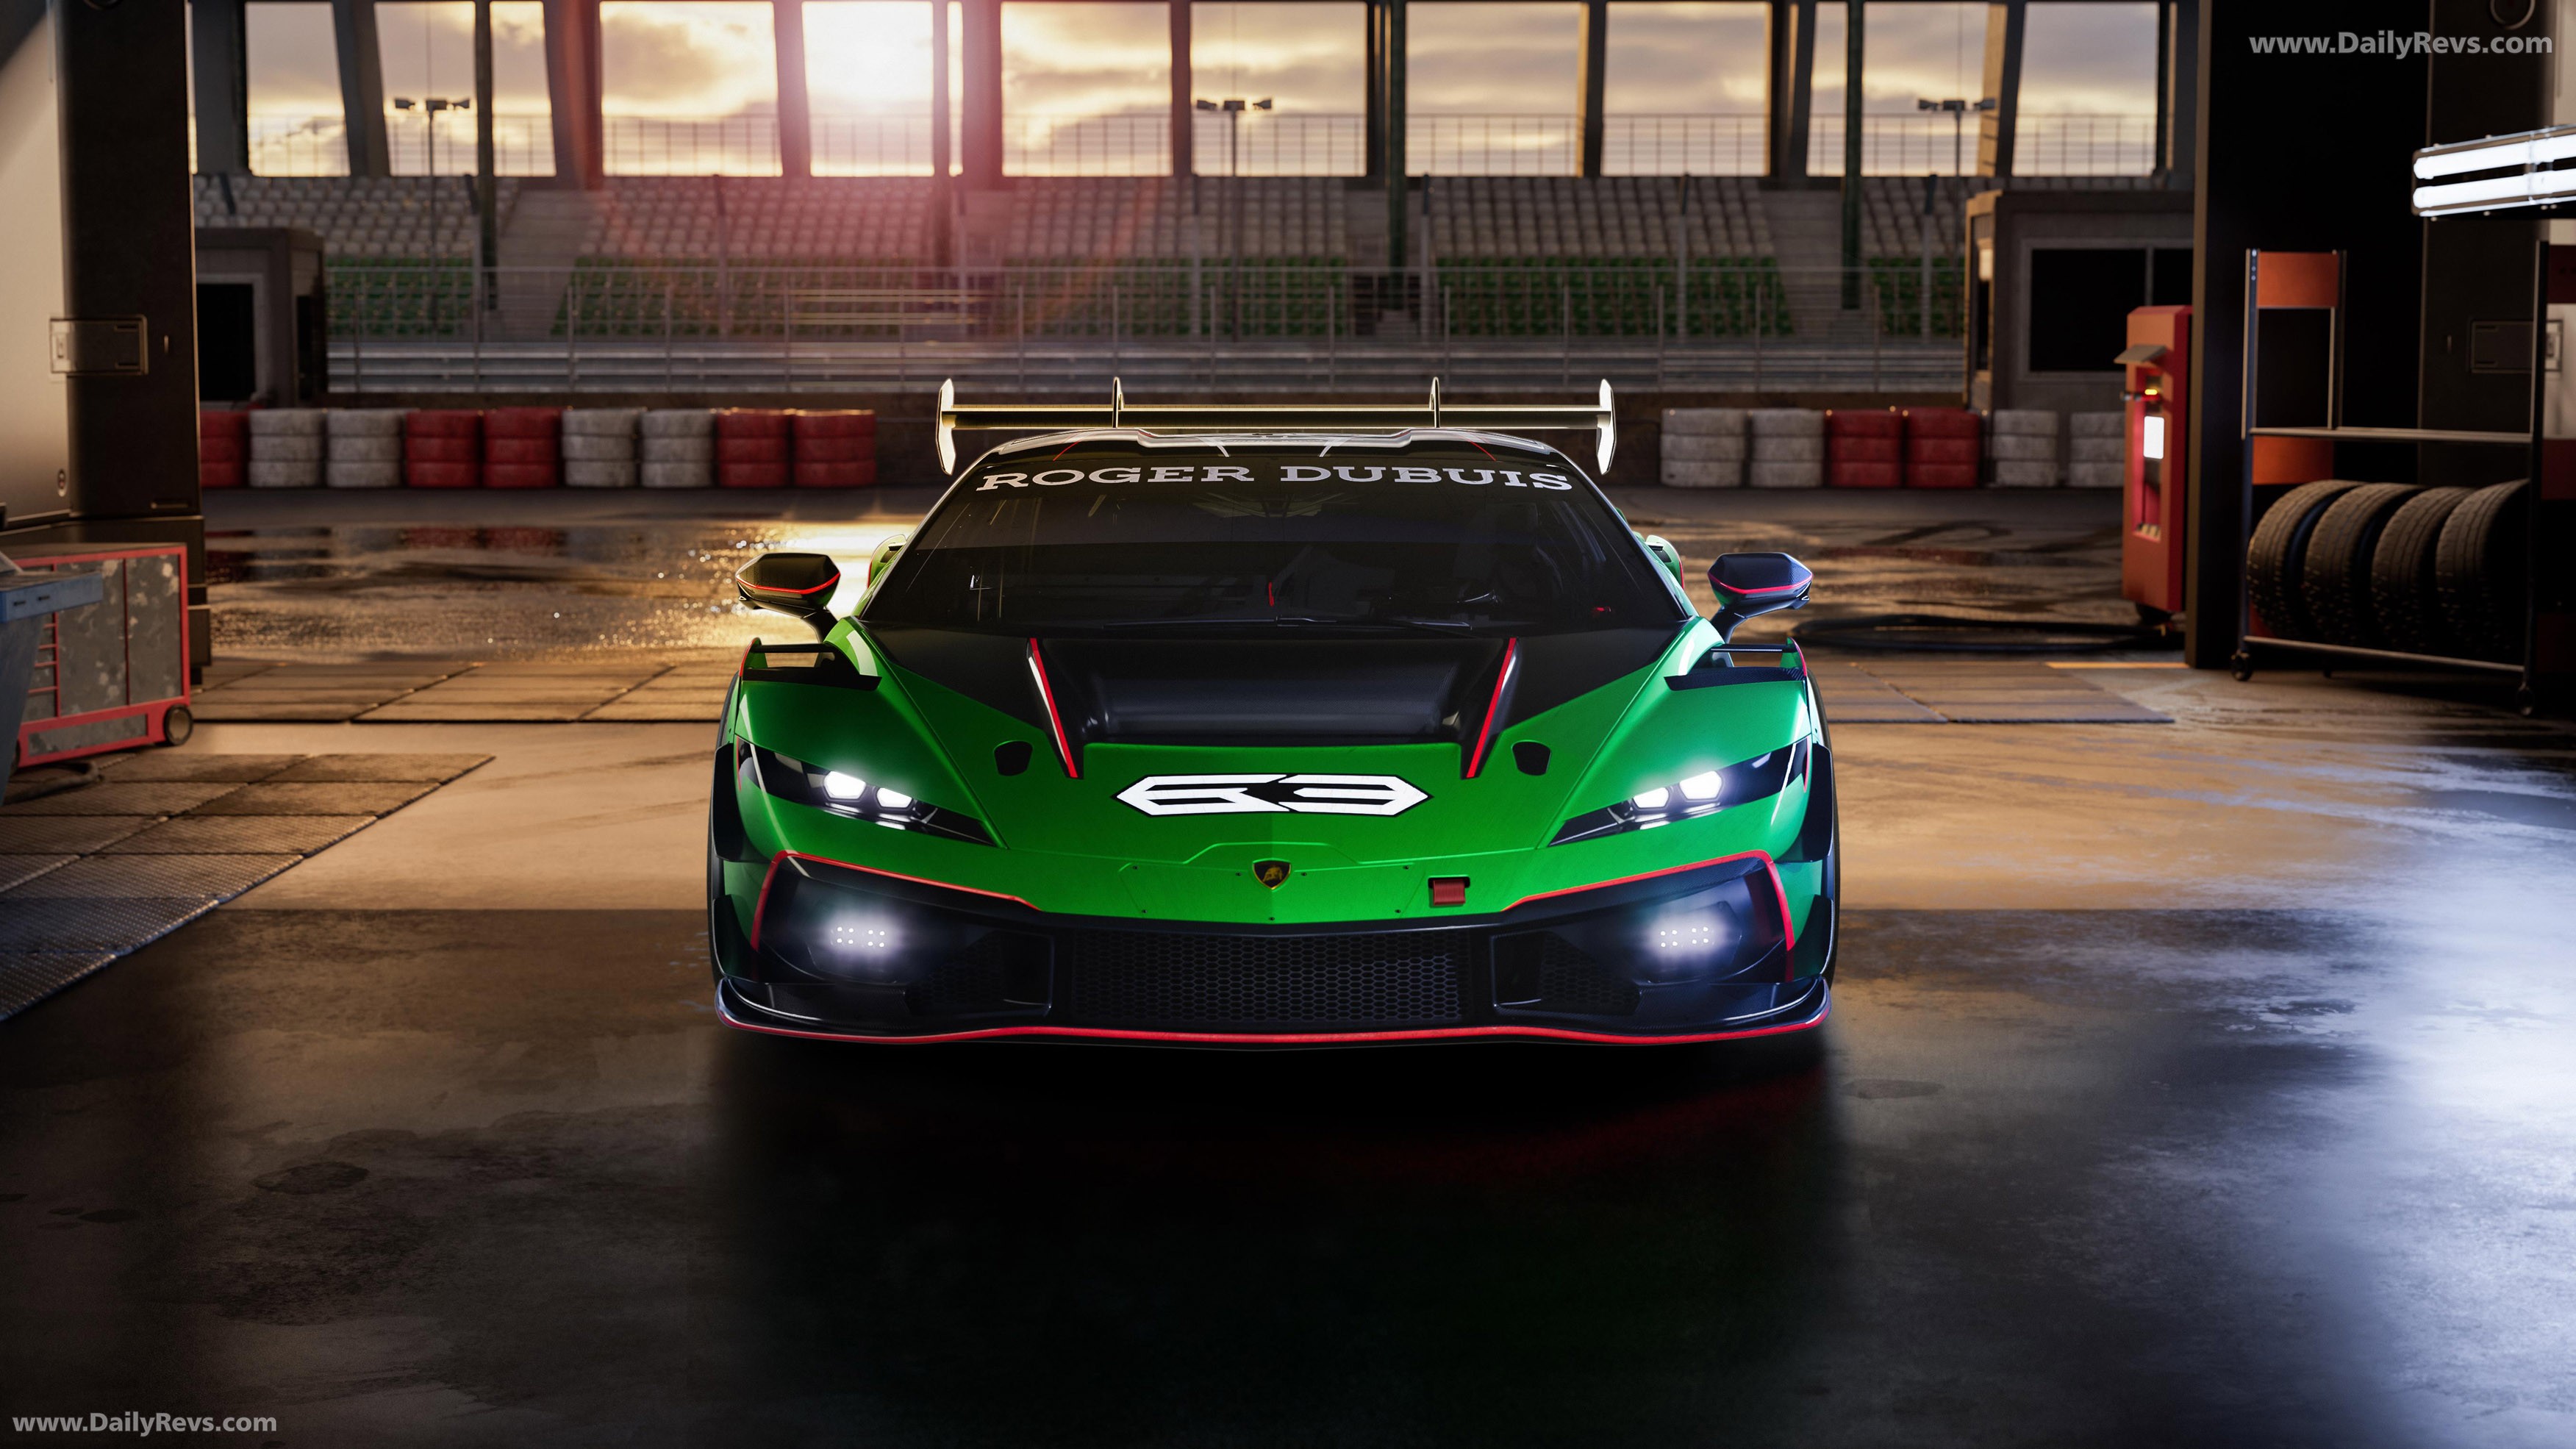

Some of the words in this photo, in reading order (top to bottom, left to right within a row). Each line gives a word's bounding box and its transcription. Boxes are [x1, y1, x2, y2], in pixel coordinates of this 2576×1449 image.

[976, 466, 1255, 491] ROGER
[1280, 465, 1573, 490] DUBUIS
[1116, 774, 1429, 815] 63
